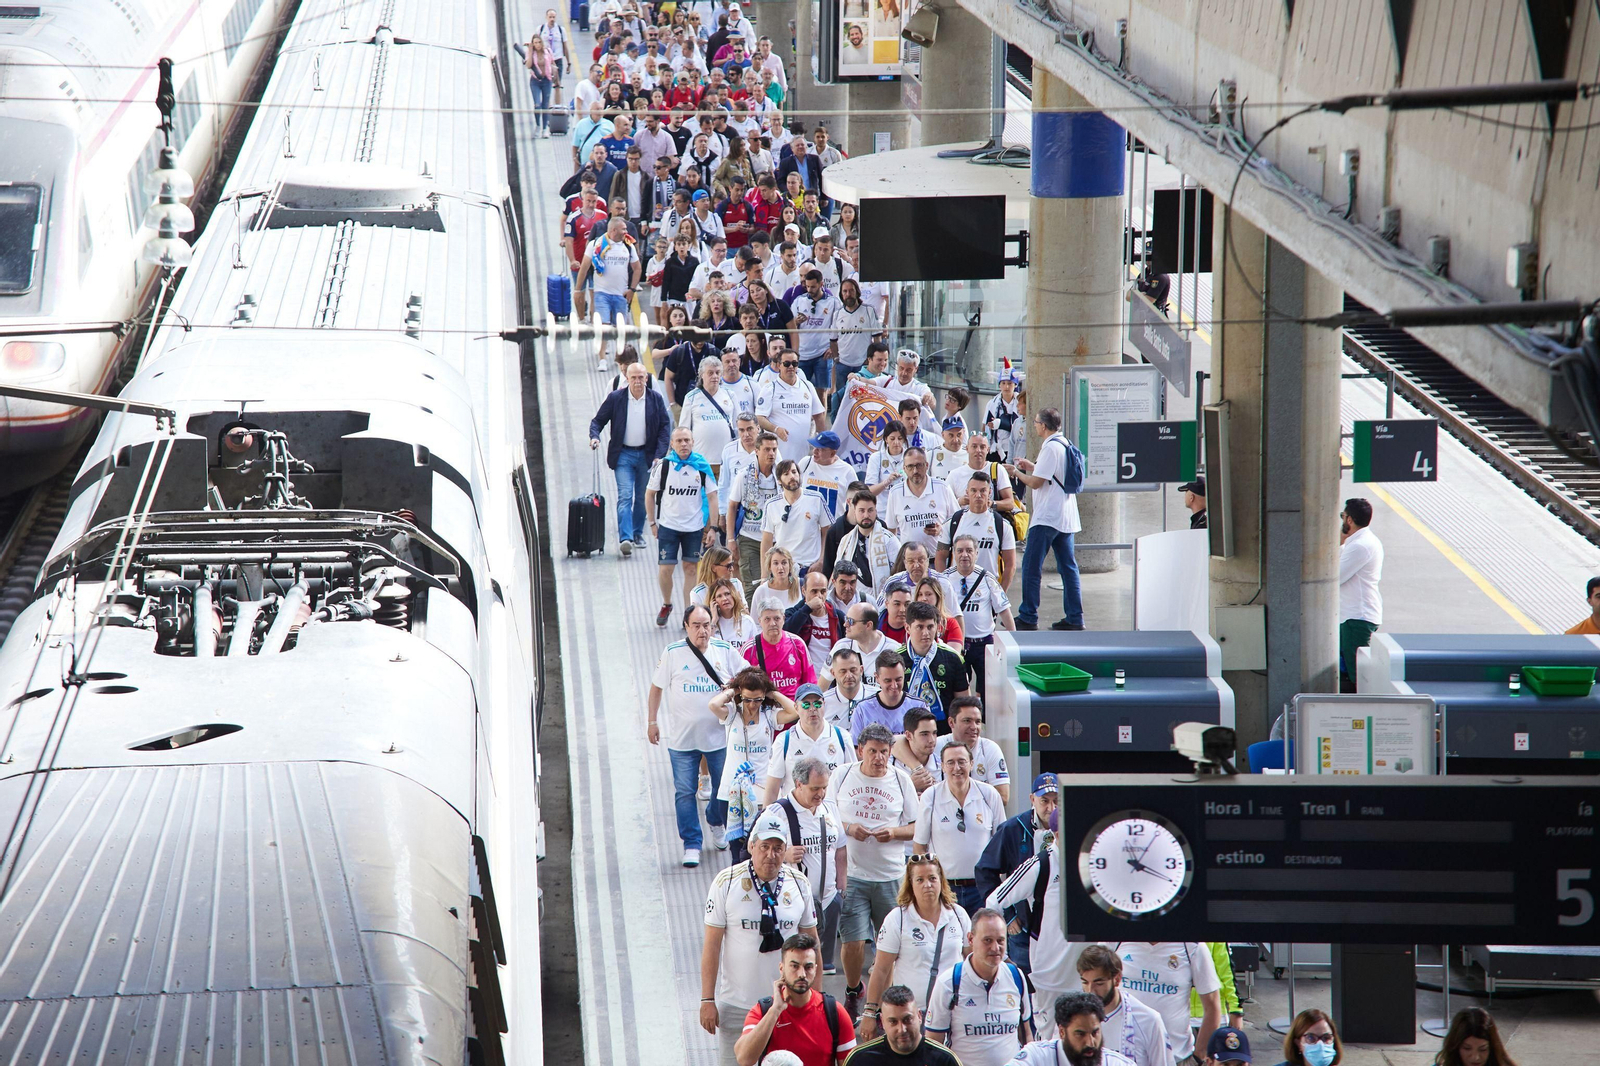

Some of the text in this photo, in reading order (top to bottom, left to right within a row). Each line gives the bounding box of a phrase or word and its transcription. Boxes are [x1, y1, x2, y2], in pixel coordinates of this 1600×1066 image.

[781, 401, 810, 409] Emirates
[1158, 425, 1171, 434] Vía
[1375, 424, 1388, 433] Vía
[1121, 452, 1137, 480] 5
[1412, 450, 1433, 478] 4
[806, 477, 839, 489] CHAMPIONS
[668, 485, 698, 496] bwin
[904, 513, 939, 523] Emirates
[811, 628, 831, 637] evi's
[696, 676, 709, 684] Fly
[770, 671, 784, 679] Fly
[683, 683, 721, 693] Emirate
[733, 744, 768, 753] Emrates
[848, 786, 895, 803] LEVI STRAUSS
[1205, 801, 1241, 815] Hora
[1260, 806, 1283, 815] TIME
[1301, 802, 1336, 815] Tren
[855, 811, 869, 819] AND
[1127, 824, 1145, 836] 12
[1546, 826, 1594, 836] PLATFORM
[800, 832, 837, 846] Emirtes
[1095, 857, 1107, 870] 9
[1165, 857, 1177, 870] 3
[1284, 855, 1342, 865] DESTINATION
[1131, 891, 1143, 904] 6
[1556, 868, 1595, 926] 5
[741, 918, 794, 930] Emtes
[1141, 969, 1160, 982] Fly
[1122, 976, 1179, 995] Emirates
[984, 1012, 1001, 1022] Fly
